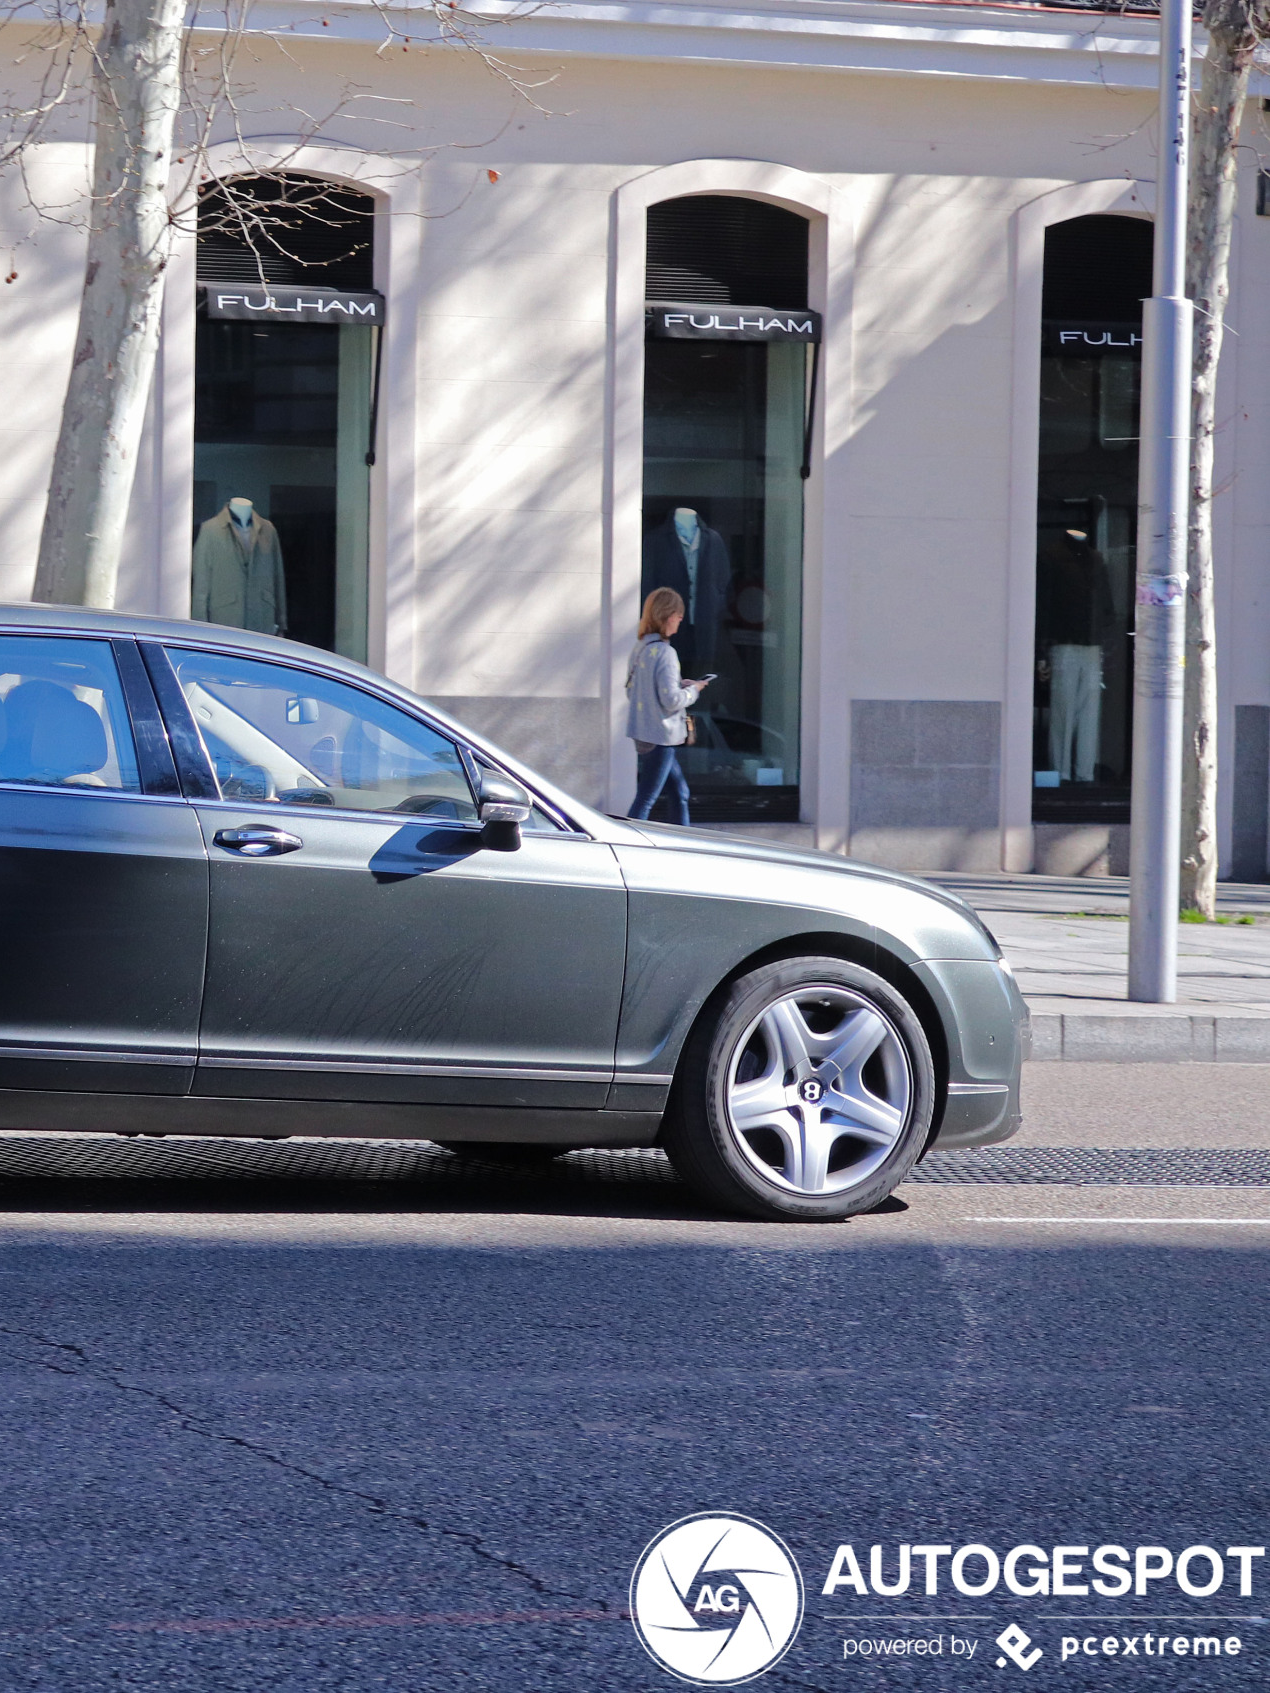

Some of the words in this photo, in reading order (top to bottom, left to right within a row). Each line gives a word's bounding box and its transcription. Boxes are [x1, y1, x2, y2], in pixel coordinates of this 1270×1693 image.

[216, 294, 377, 317] FULHAM
[663, 313, 814, 334] FULHAM
[1059, 330, 1144, 347] FULH
